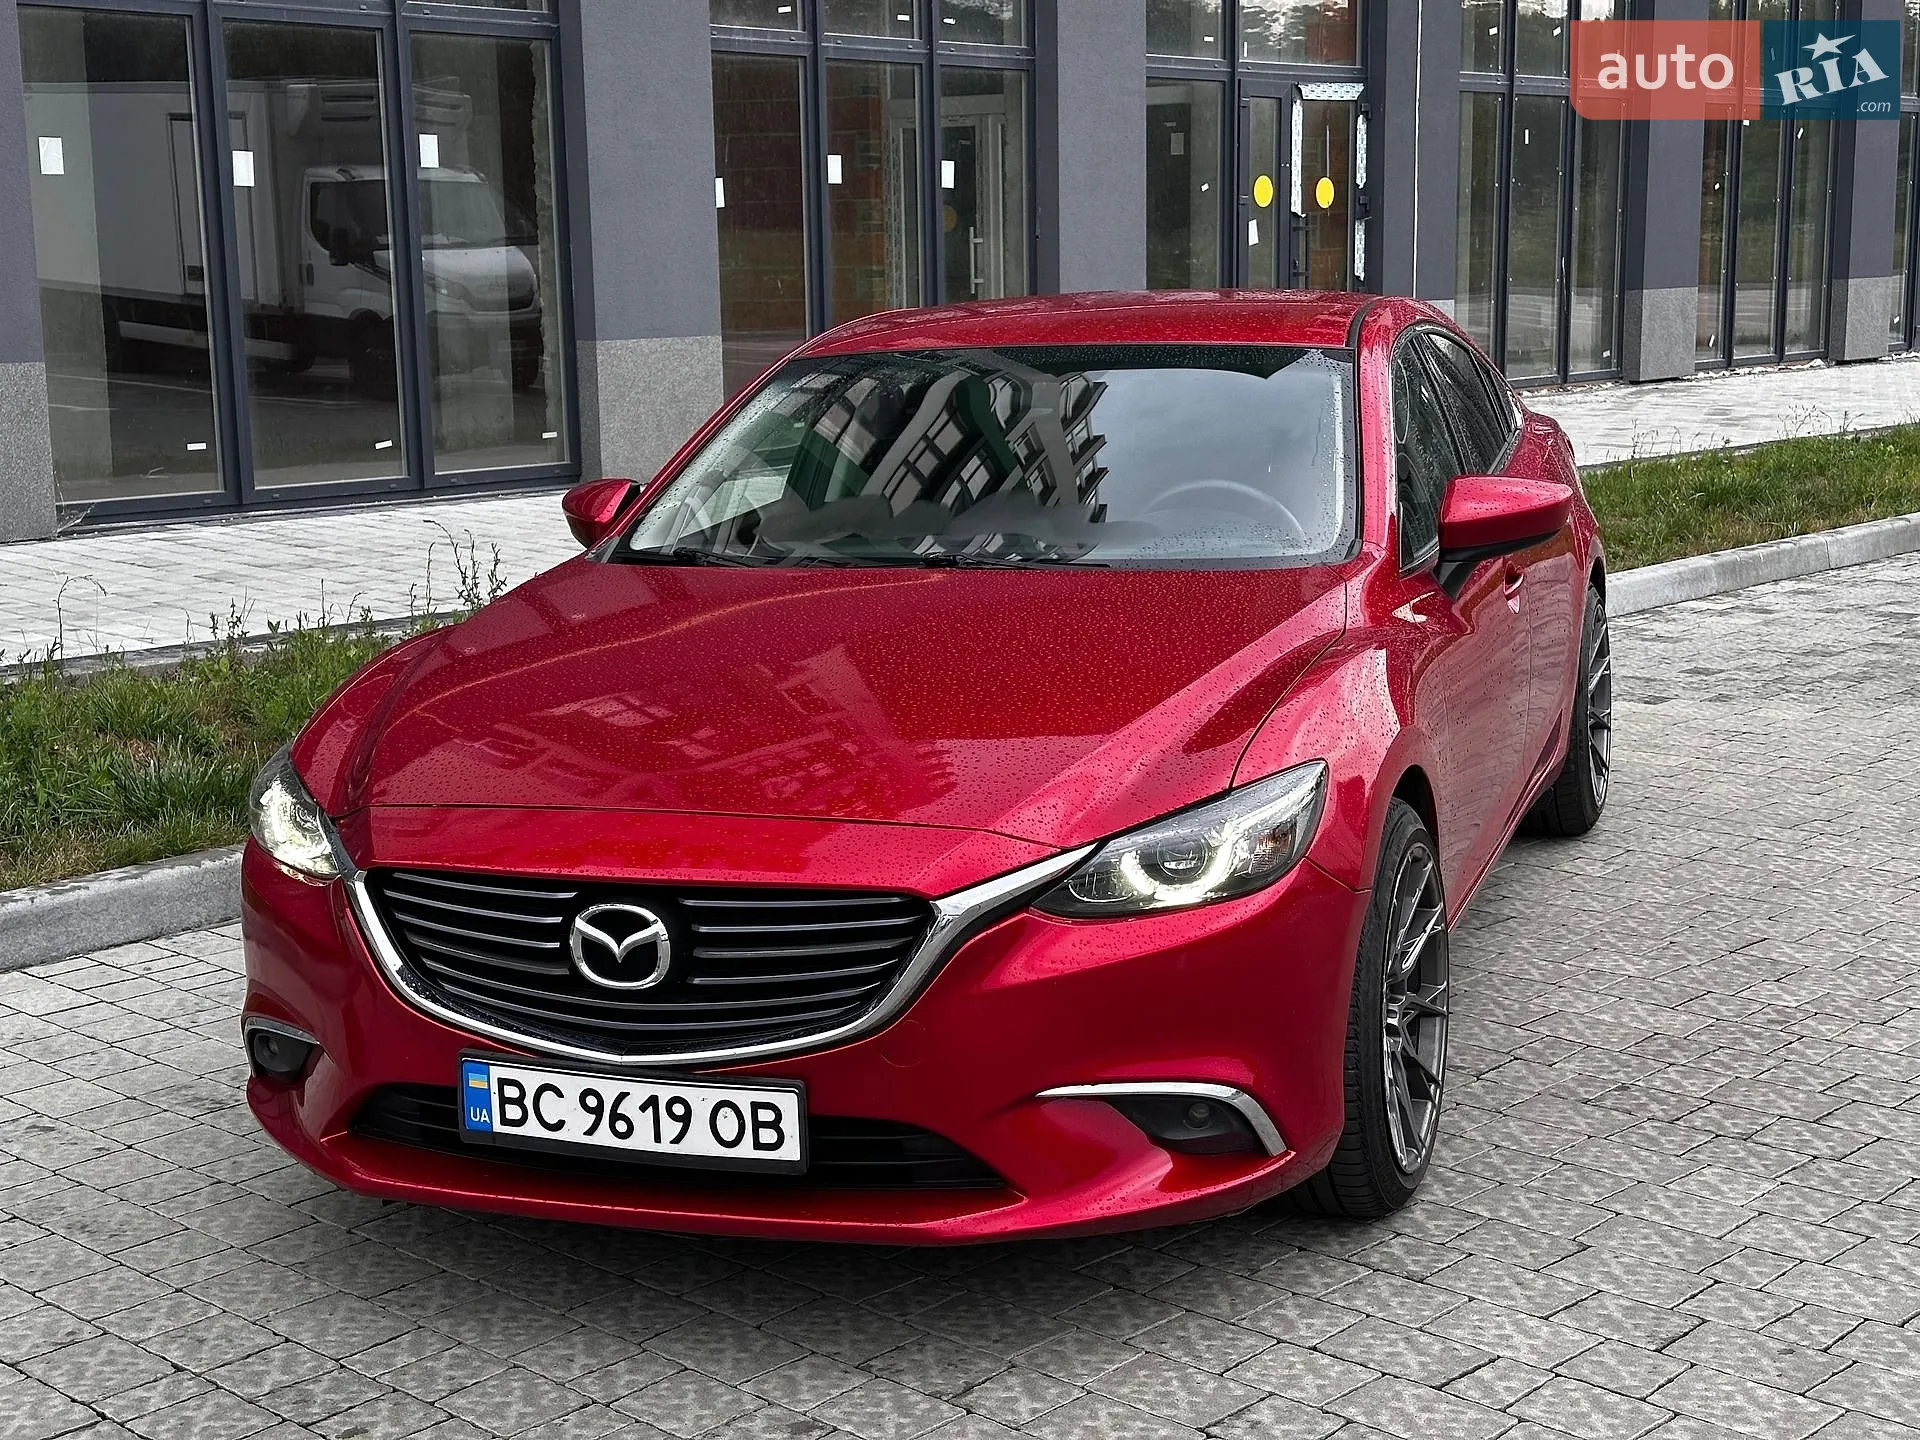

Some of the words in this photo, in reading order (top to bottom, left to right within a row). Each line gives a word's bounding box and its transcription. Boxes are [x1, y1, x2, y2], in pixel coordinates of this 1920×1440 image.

[469, 1107, 491, 1124] UA
[497, 1077, 567, 1132] BC
[578, 1087, 692, 1145] 9619
[709, 1099, 786, 1152] OB
